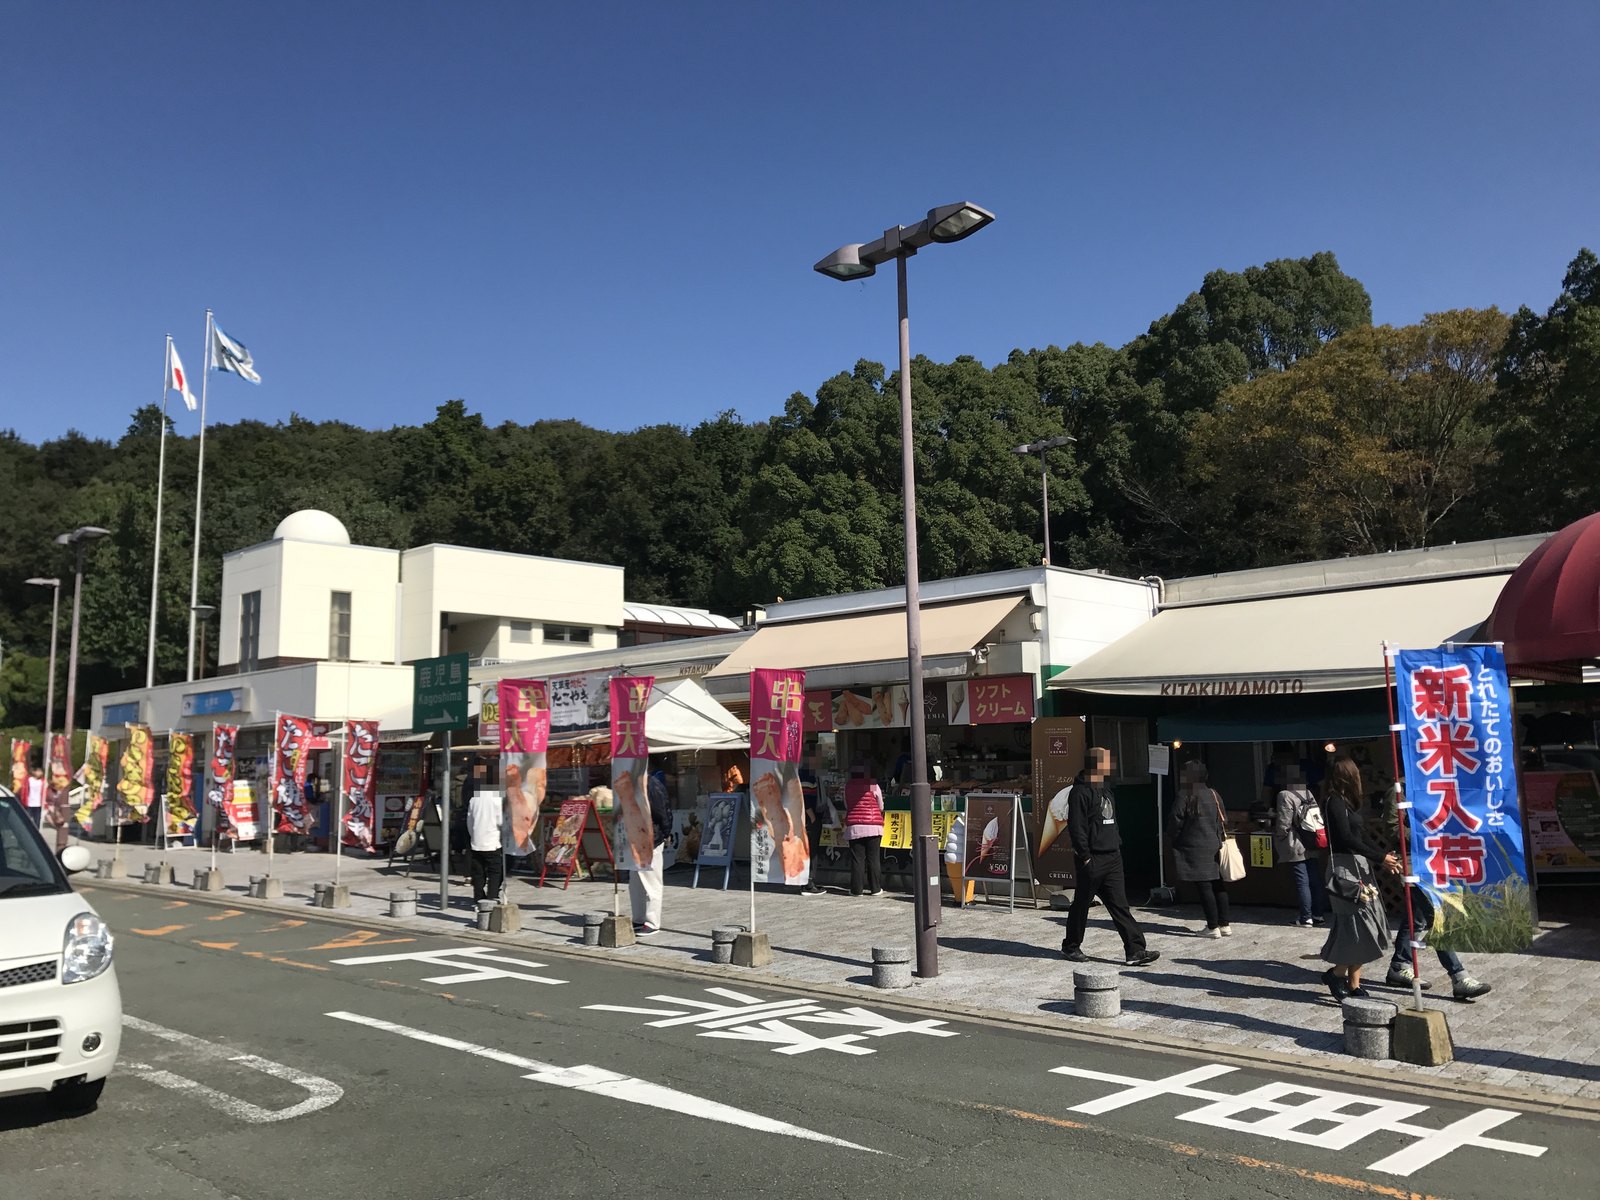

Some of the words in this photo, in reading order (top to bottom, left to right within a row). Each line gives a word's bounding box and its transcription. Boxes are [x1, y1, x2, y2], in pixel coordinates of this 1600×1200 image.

[419, 661, 462, 688] 鹿児島
[976, 684, 1011, 699] ソフト
[1160, 679, 1304, 695] KITAKUMAMOTO
[418, 690, 462, 706] Kagoshima
[552, 688, 589, 707] たこやき
[757, 677, 801, 759] 串天
[976, 701, 1027, 717] クリーム
[1477, 664, 1505, 826] とれたてのおいしさ
[1411, 664, 1487, 888] 新米入荷
[889, 813, 900, 847] 明太マヨ串
[989, 863, 1008, 873] ¥500
